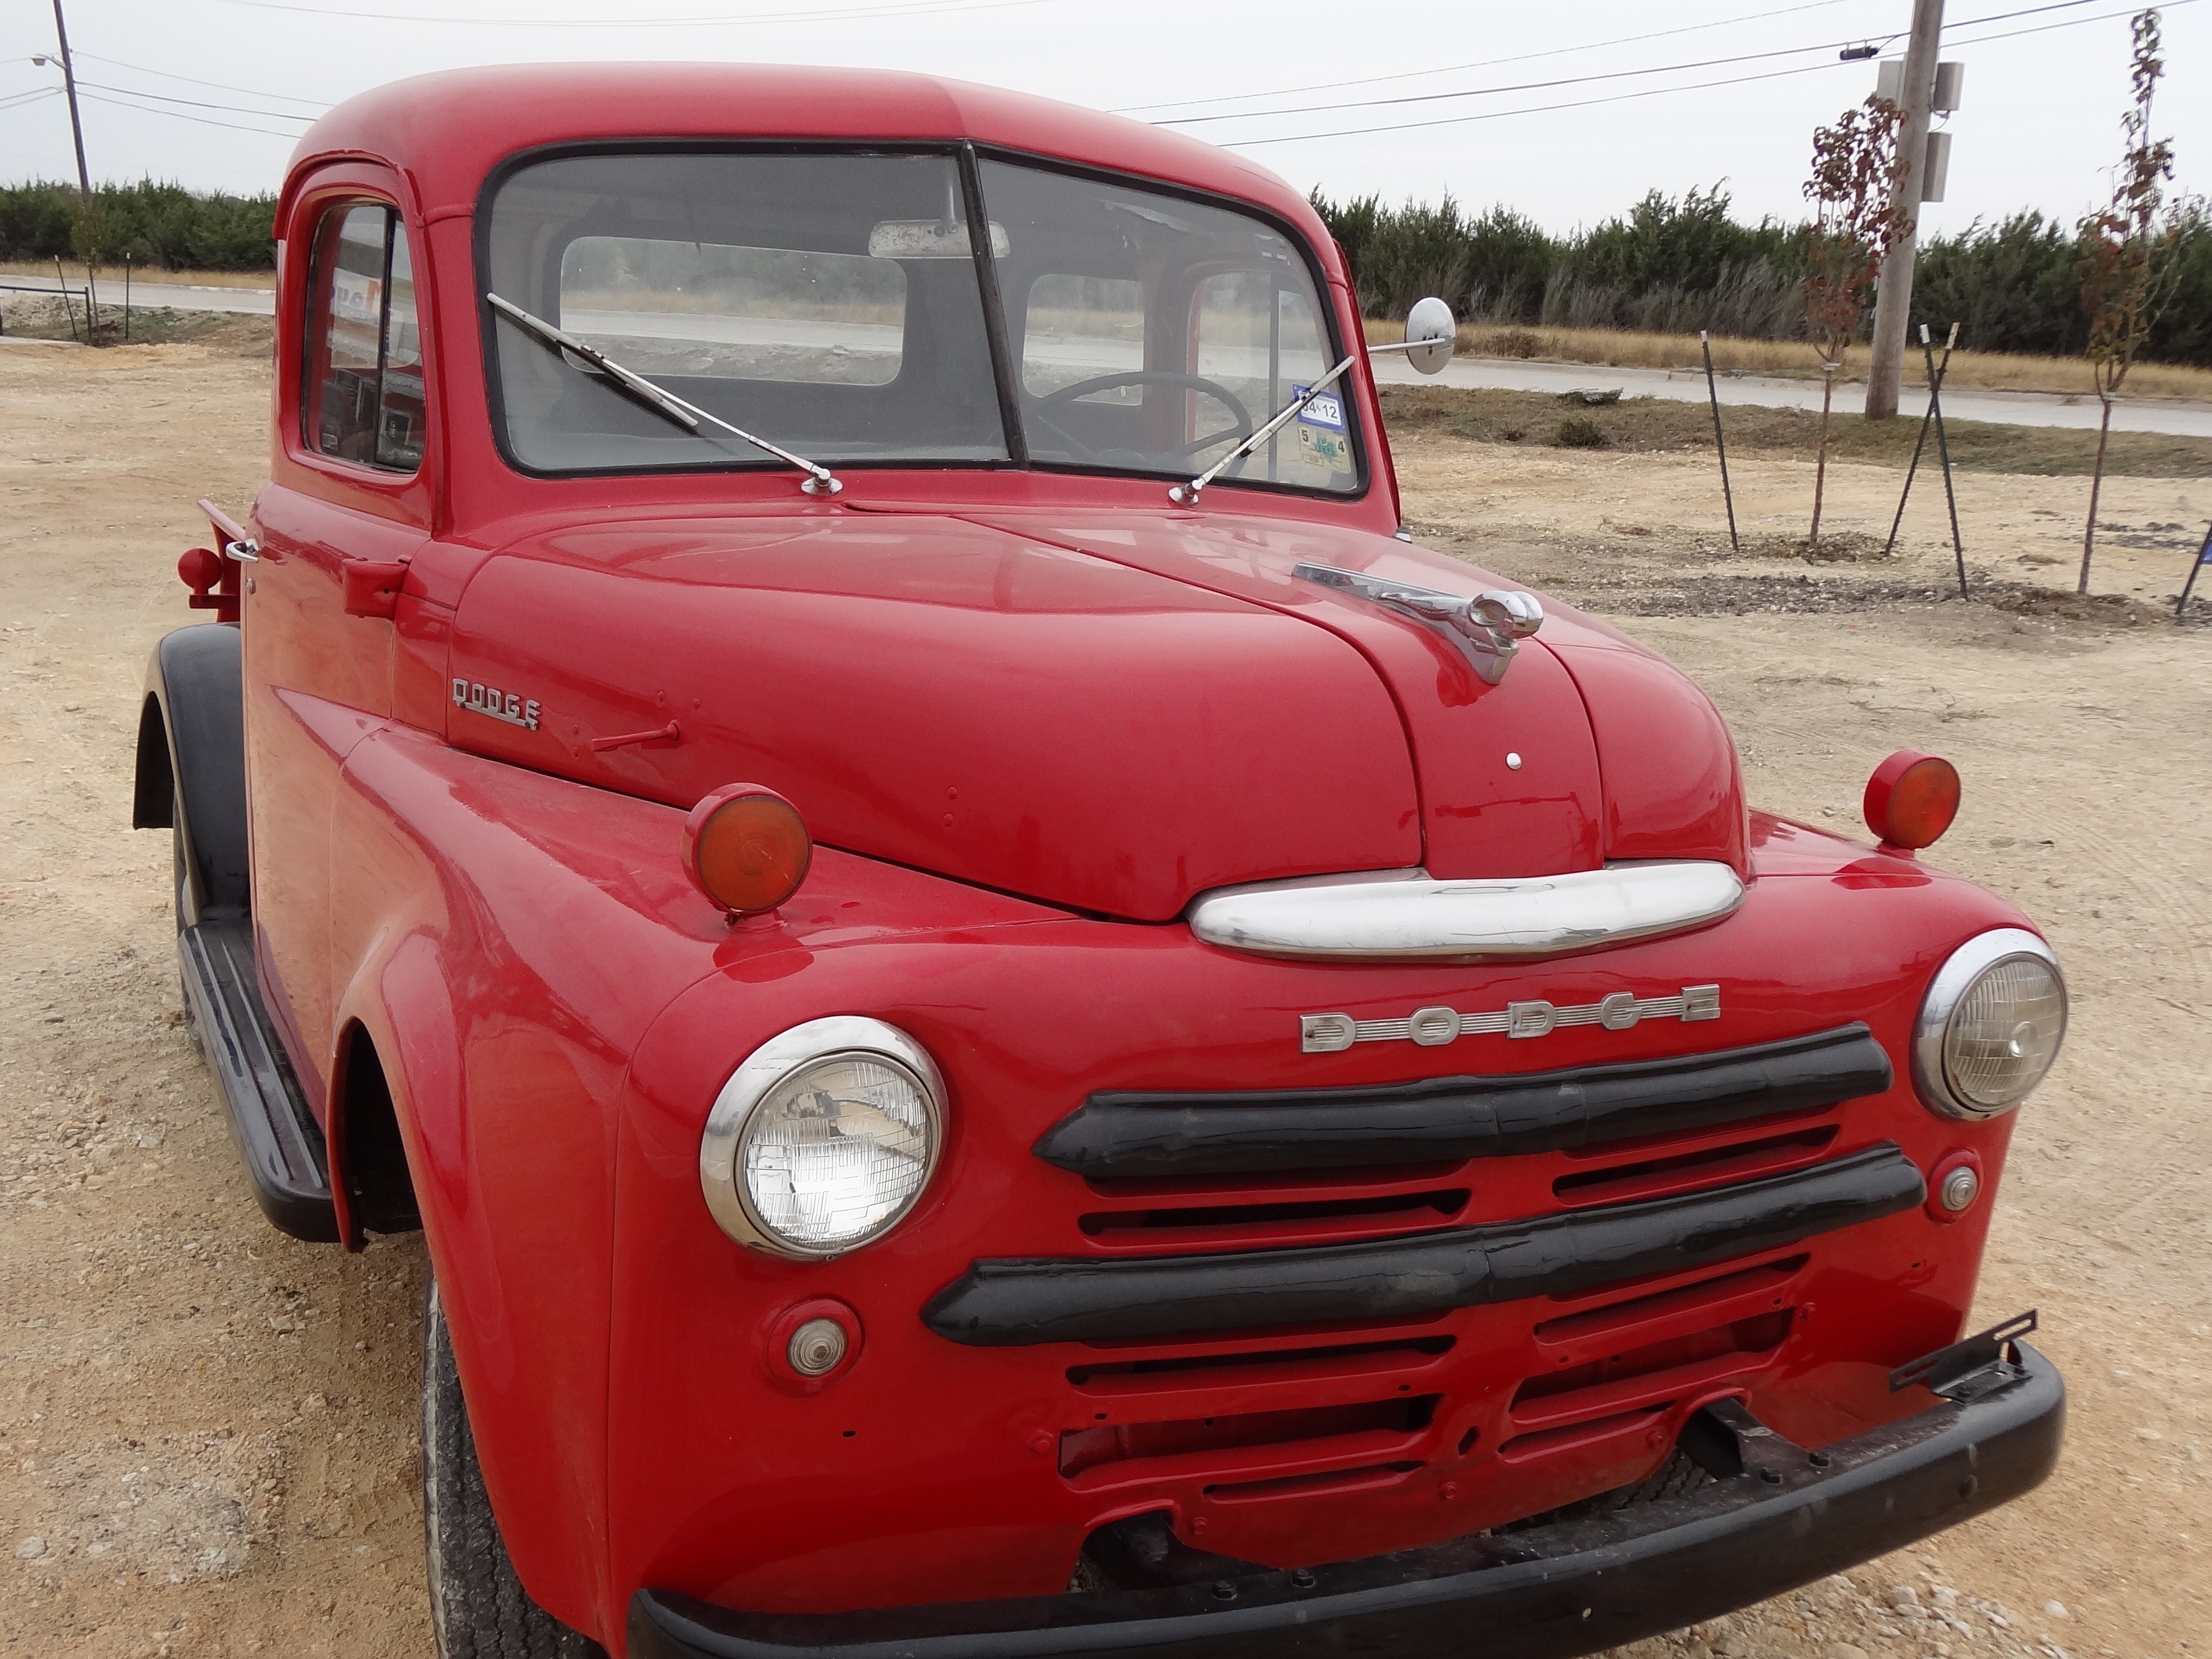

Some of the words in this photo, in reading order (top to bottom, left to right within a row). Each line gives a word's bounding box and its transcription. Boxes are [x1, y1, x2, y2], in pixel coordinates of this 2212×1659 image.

[1322, 404, 1338, 419] 12
[1301, 430, 1309, 442] 5
[1337, 441, 1345, 453] 4
[452, 678, 540, 731] DODGE
[1299, 984, 1721, 1053] DODGE
